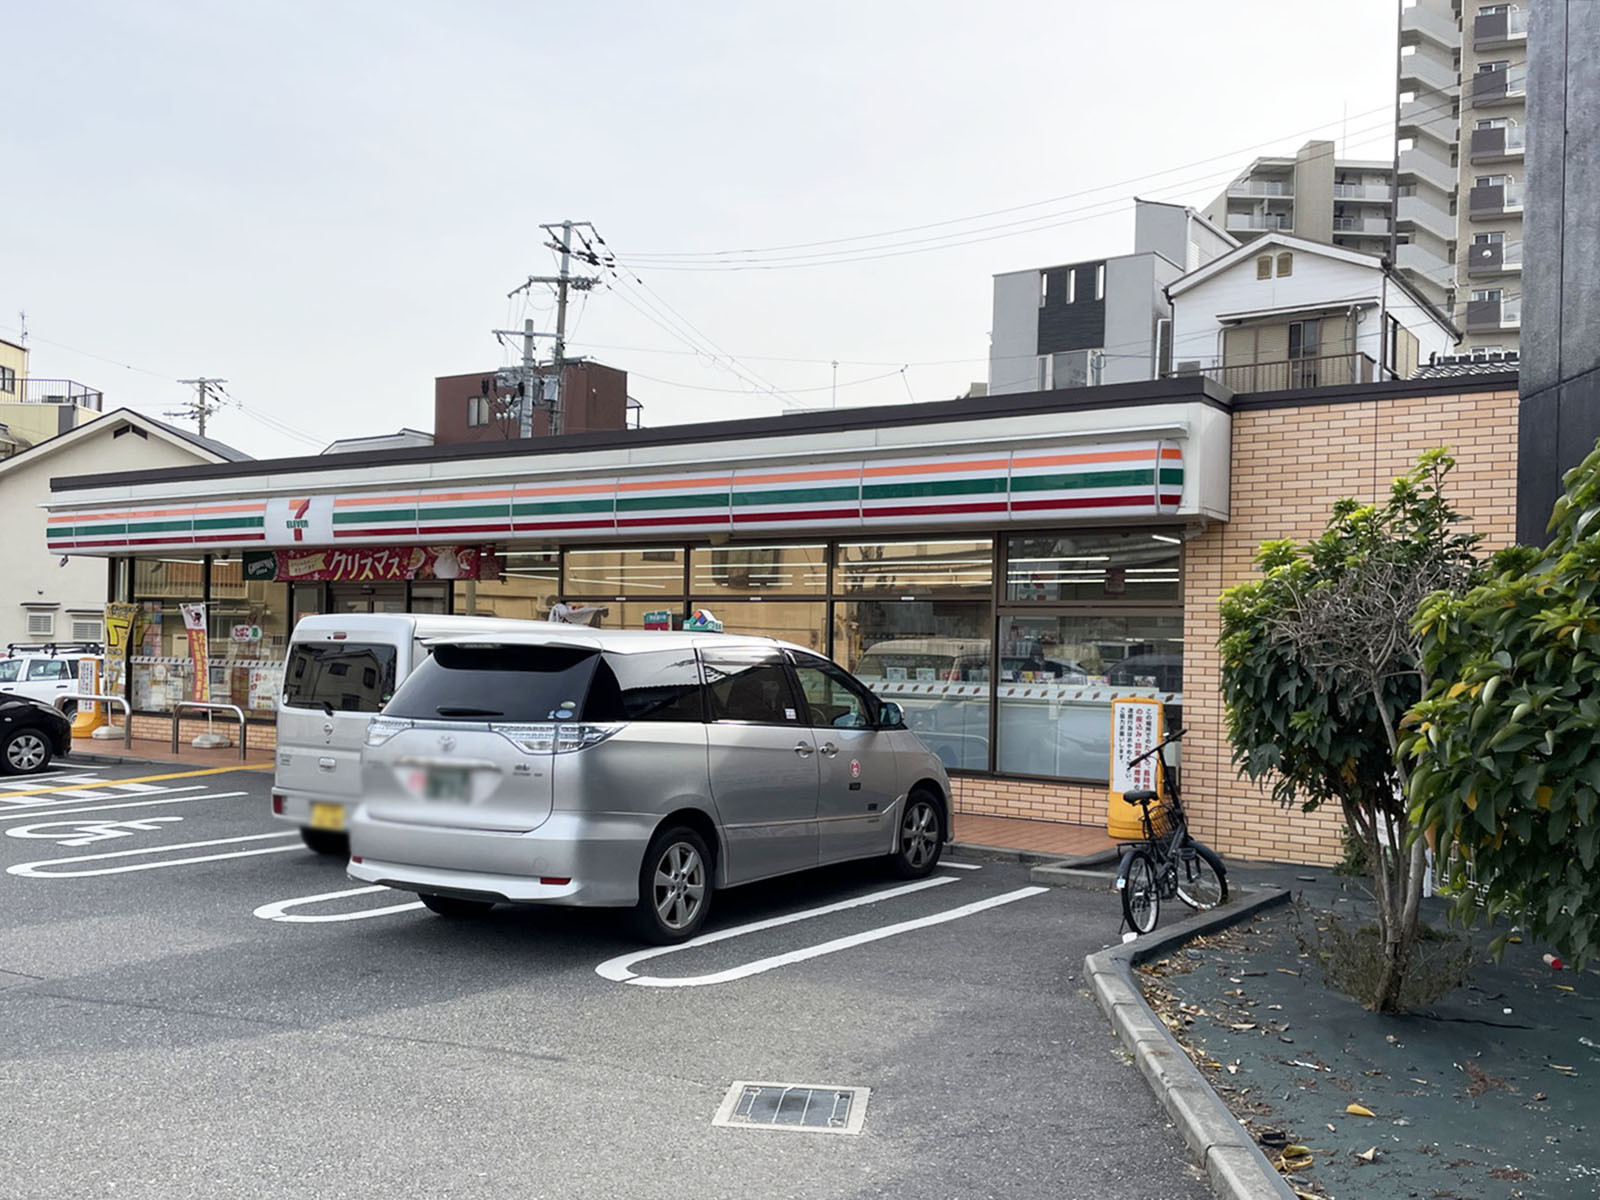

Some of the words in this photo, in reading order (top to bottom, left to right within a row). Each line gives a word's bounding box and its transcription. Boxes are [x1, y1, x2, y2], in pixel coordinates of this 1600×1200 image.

[289, 499, 310, 541] 7
[329, 550, 400, 581] クリスマス
